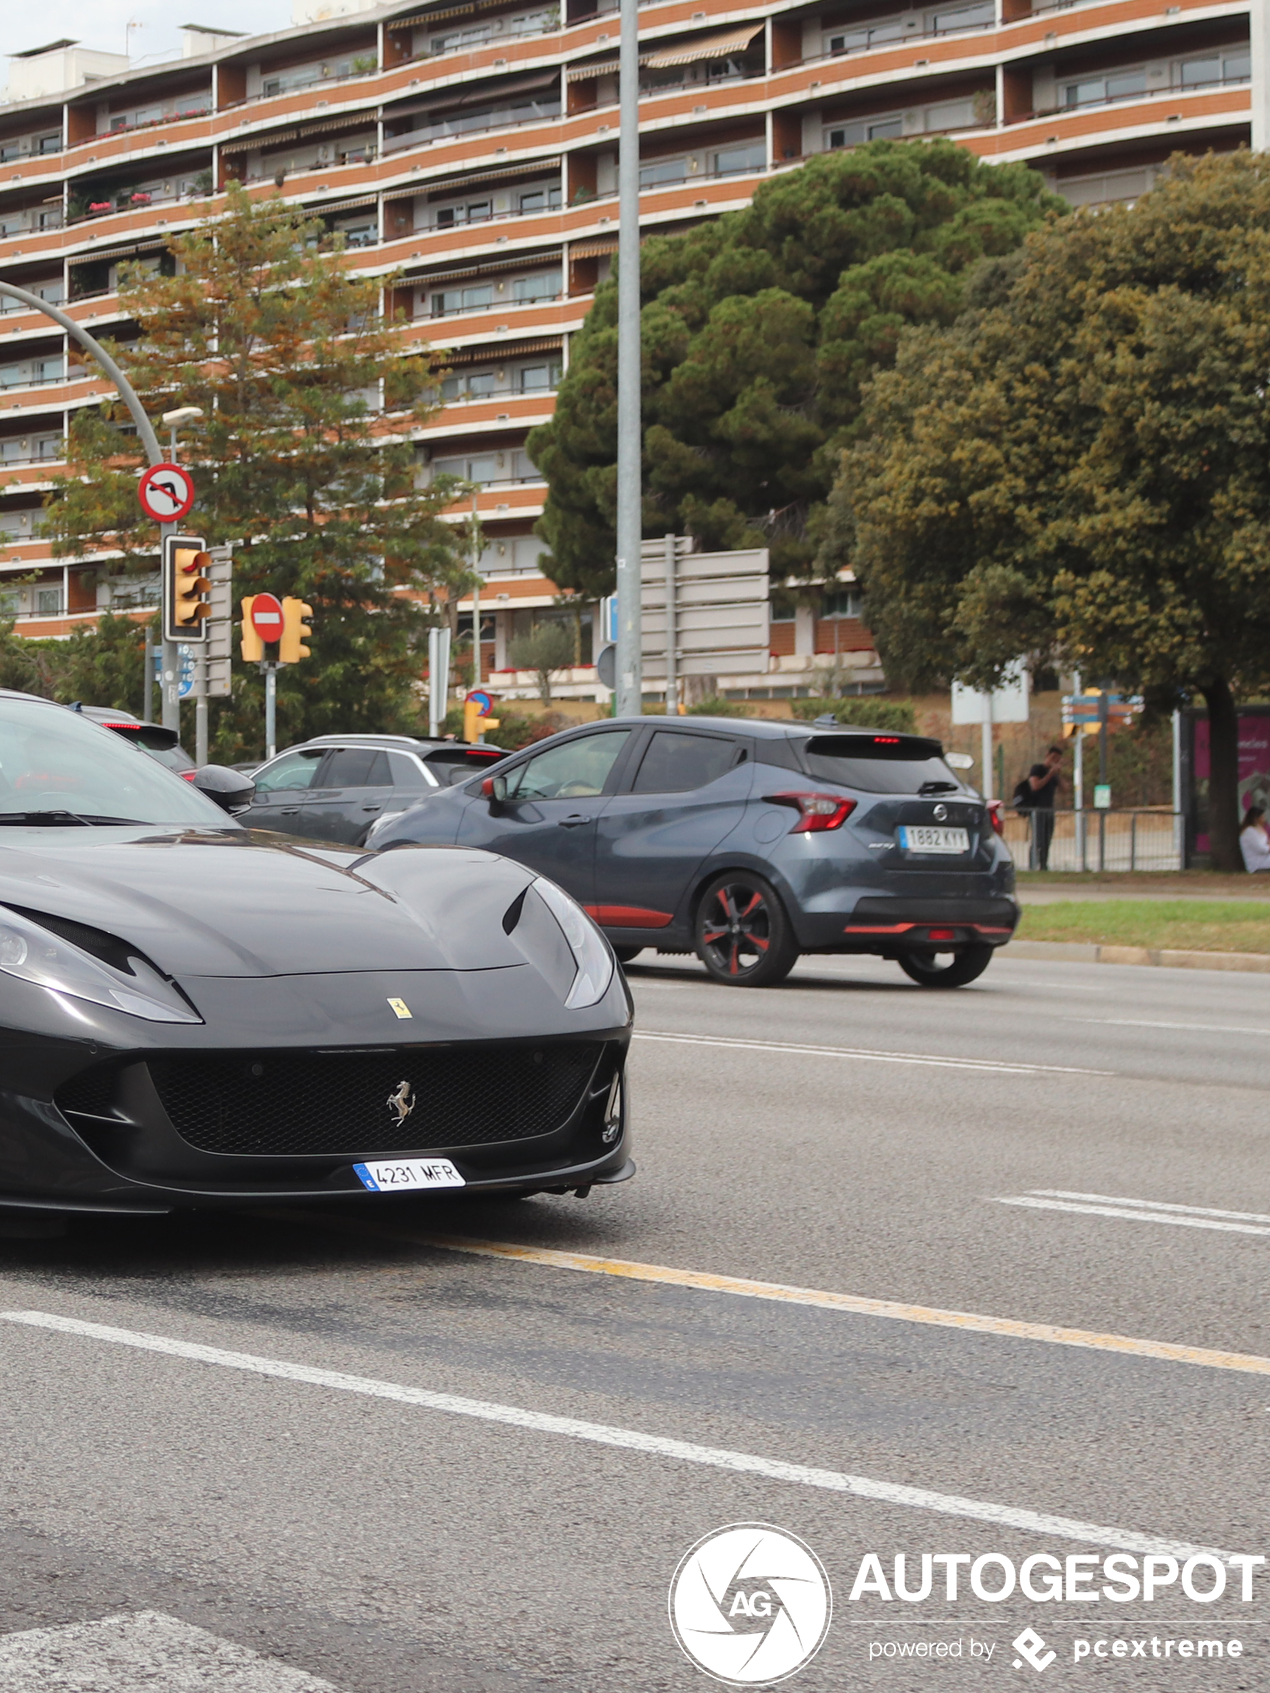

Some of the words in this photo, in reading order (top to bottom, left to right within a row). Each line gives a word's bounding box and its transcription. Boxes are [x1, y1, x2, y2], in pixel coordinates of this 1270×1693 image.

[910, 829, 941, 846] 1882
[375, 1166, 418, 1184] 4231
[420, 1165, 459, 1181] MFR
